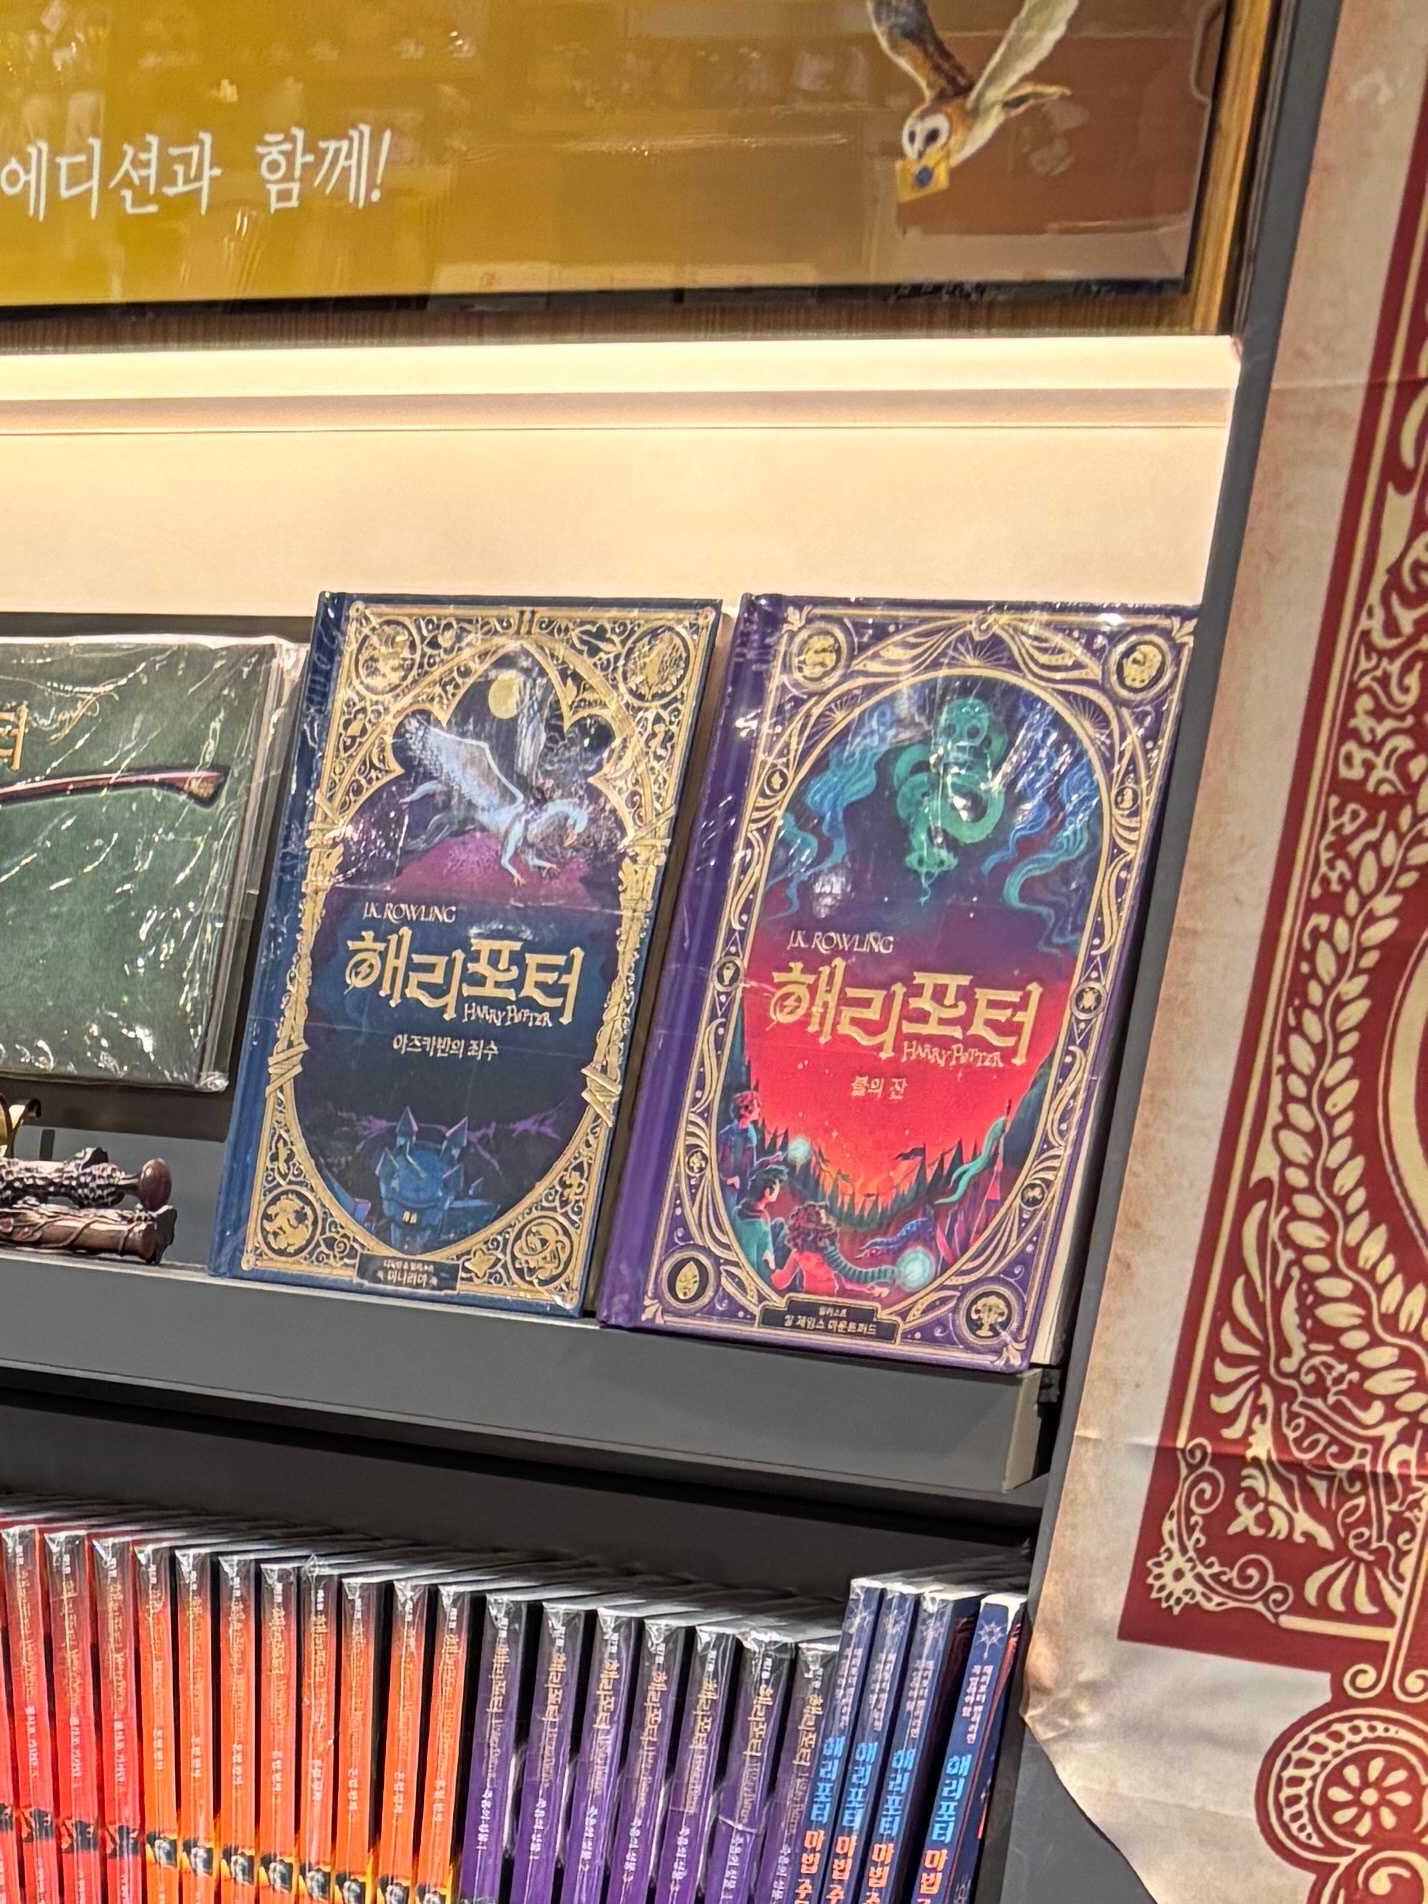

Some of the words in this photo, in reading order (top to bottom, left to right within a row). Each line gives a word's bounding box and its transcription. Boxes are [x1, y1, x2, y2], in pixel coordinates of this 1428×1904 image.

[0, 130, 223, 223] 에디션과
[255, 121, 393, 214] 함께!
[382, 902, 457, 924] ROWLING
[812, 932, 894, 954] ROWLING
[344, 926, 585, 1022] 해리포터
[462, 1003, 506, 1026] HARRY
[506, 1004, 552, 1027] POTTER
[766, 957, 1043, 1066] 해리포터
[394, 1033, 465, 1058] 아즈카반의
[467, 1039, 500, 1061] 죄수
[901, 1041, 951, 1067] HARRY
[950, 1043, 1004, 1068] POTTER
[851, 1075, 884, 1098] 불의
[890, 1077, 908, 1100] 잔
[486, 1644, 510, 1712] 해리포터
[542, 1653, 566, 1721] 해리포터
[594, 1658, 619, 1729] 해리포터
[640, 1671, 668, 1741] 해리포터
[693, 1680, 716, 1750] 해리포터
[745, 1685, 771, 1756] 해리포터
[794, 1694, 823, 1766] 해리포터
[811, 1737, 845, 1823] 해리포터
[842, 1742, 878, 1829] 해리포터
[878, 1749, 916, 1837] 해리포터
[931, 1754, 972, 1843] 해리포터
[479, 1788, 495, 1821] 죽음의
[533, 1798, 547, 1830] 죽음의
[582, 1806, 598, 1837] 죽음의
[629, 1818, 645, 1850] 죽음의
[675, 1826, 691, 1858] 죽음의
[728, 1835, 743, 1865] 죽음의
[800, 1830, 826, 1874] 마법
[774, 1844, 791, 1877] 죽음의
[831, 1835, 857, 1880] 마법
[868, 1843, 894, 1888] 마법
[920, 1849, 948, 1895] 마법
